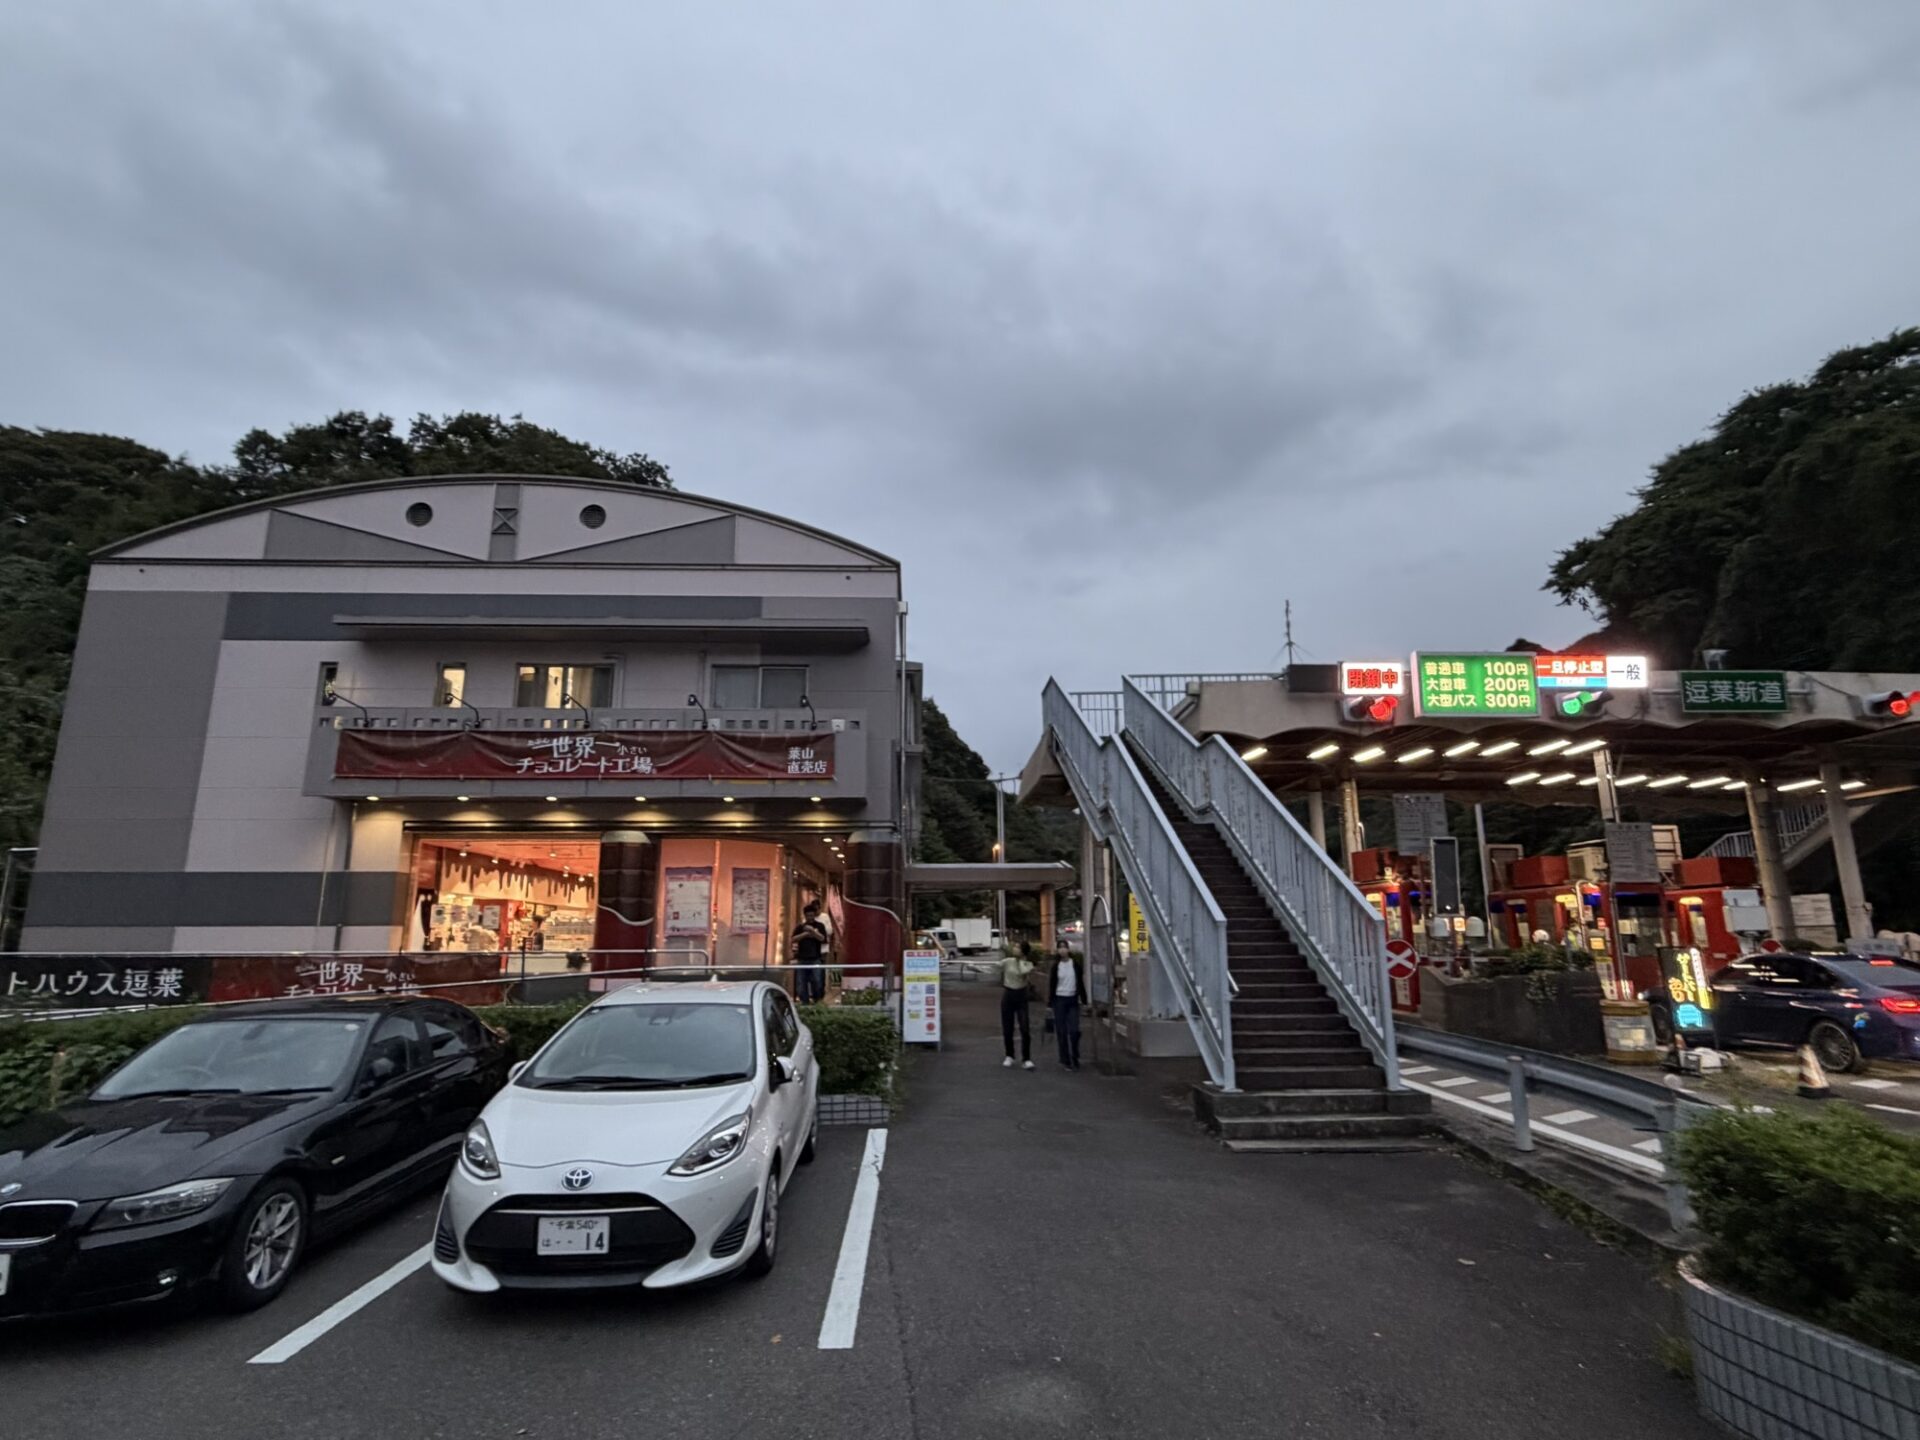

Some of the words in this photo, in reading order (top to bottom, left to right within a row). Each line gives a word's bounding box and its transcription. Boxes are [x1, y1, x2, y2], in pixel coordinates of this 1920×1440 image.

[1424, 662, 1466, 676] 普通車
[1484, 661, 1529, 676] 100円
[1610, 663, 1641, 681] 一般
[1426, 678, 1467, 692] 大型車
[1484, 678, 1530, 692] 200円
[1685, 680, 1783, 703] 逗葉新道
[1427, 694, 1478, 708] 大型バス
[1484, 694, 1531, 708] 300円
[788, 746, 814, 760] 葉山
[516, 756, 653, 774] チョコレート工場
[787, 760, 828, 774] 直売店
[7, 967, 184, 998] トハウス逗葉
